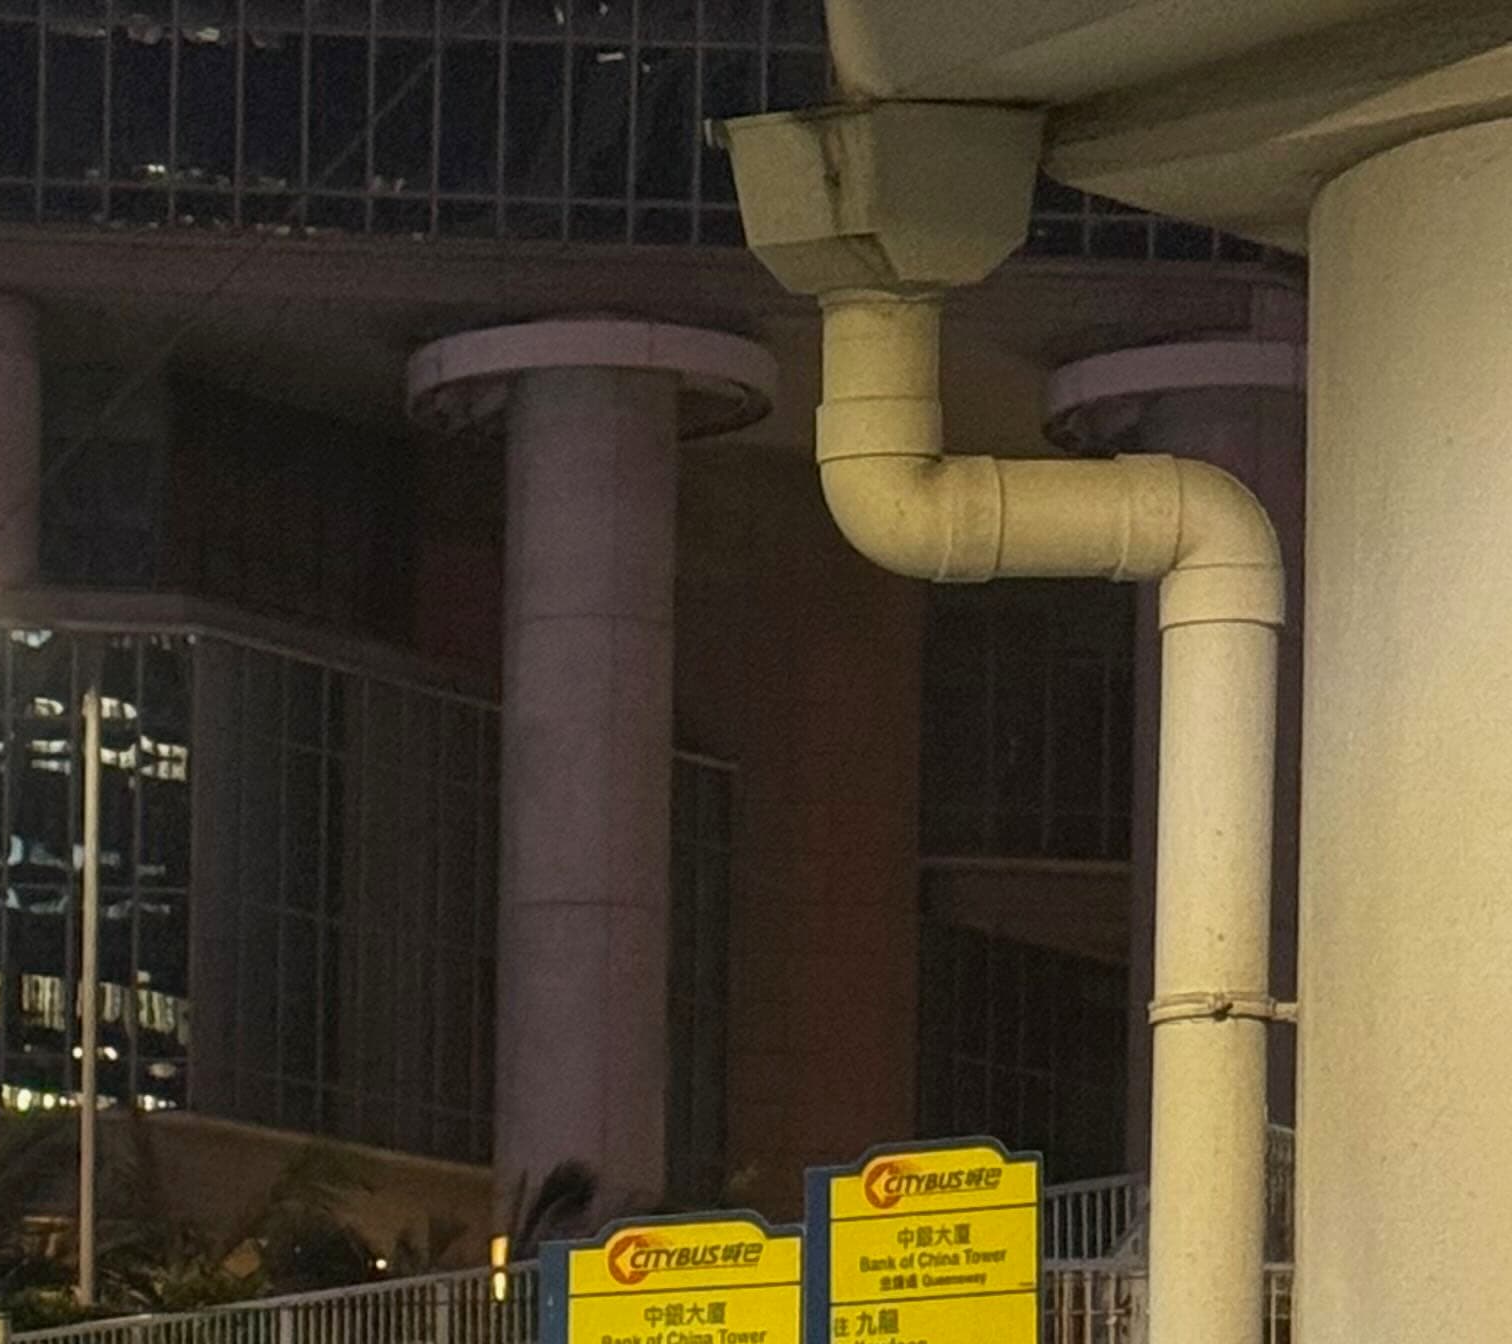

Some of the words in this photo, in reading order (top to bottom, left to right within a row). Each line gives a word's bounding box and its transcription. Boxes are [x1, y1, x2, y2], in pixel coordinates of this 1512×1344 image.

[884, 1171, 964, 1195] CITYBUS
[897, 1224, 971, 1249] 中銀大廈
[630, 1245, 720, 1270] CITYBUS
[860, 1255, 896, 1273] Bank
[899, 1254, 915, 1270] of
[917, 1252, 960, 1269] China
[963, 1249, 1007, 1265] Tower
[921, 1272, 987, 1288] Queensway
[644, 1302, 726, 1327] 中銀大廈
[856, 1309, 899, 1337] 九龍
[718, 1329, 766, 1344] Tower
